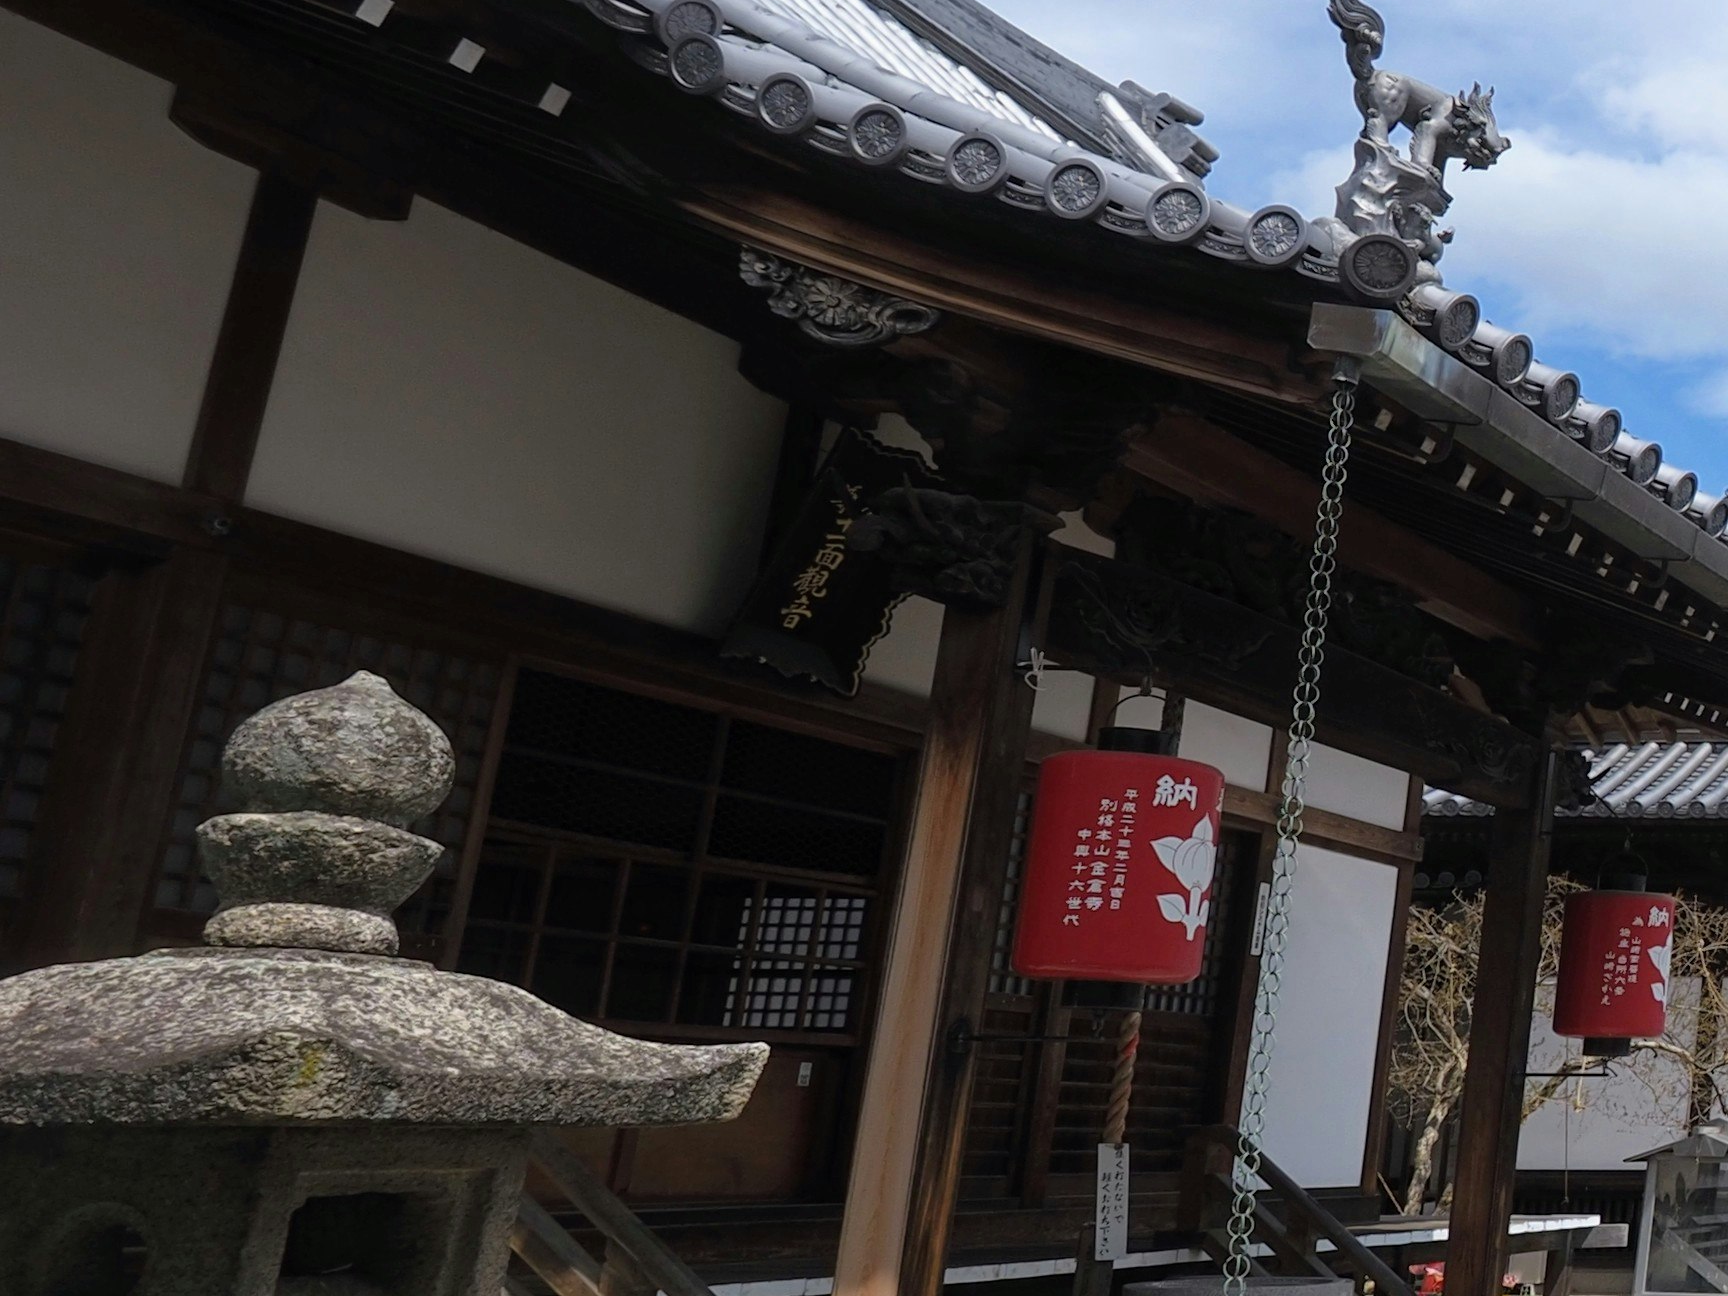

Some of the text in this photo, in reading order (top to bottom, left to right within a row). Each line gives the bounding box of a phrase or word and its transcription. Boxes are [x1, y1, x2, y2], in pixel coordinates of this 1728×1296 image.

[1152, 774, 1198, 811] 納
[1083, 798, 1119, 911] 別格本山金倉寺
[1647, 906, 1669, 928] 納
